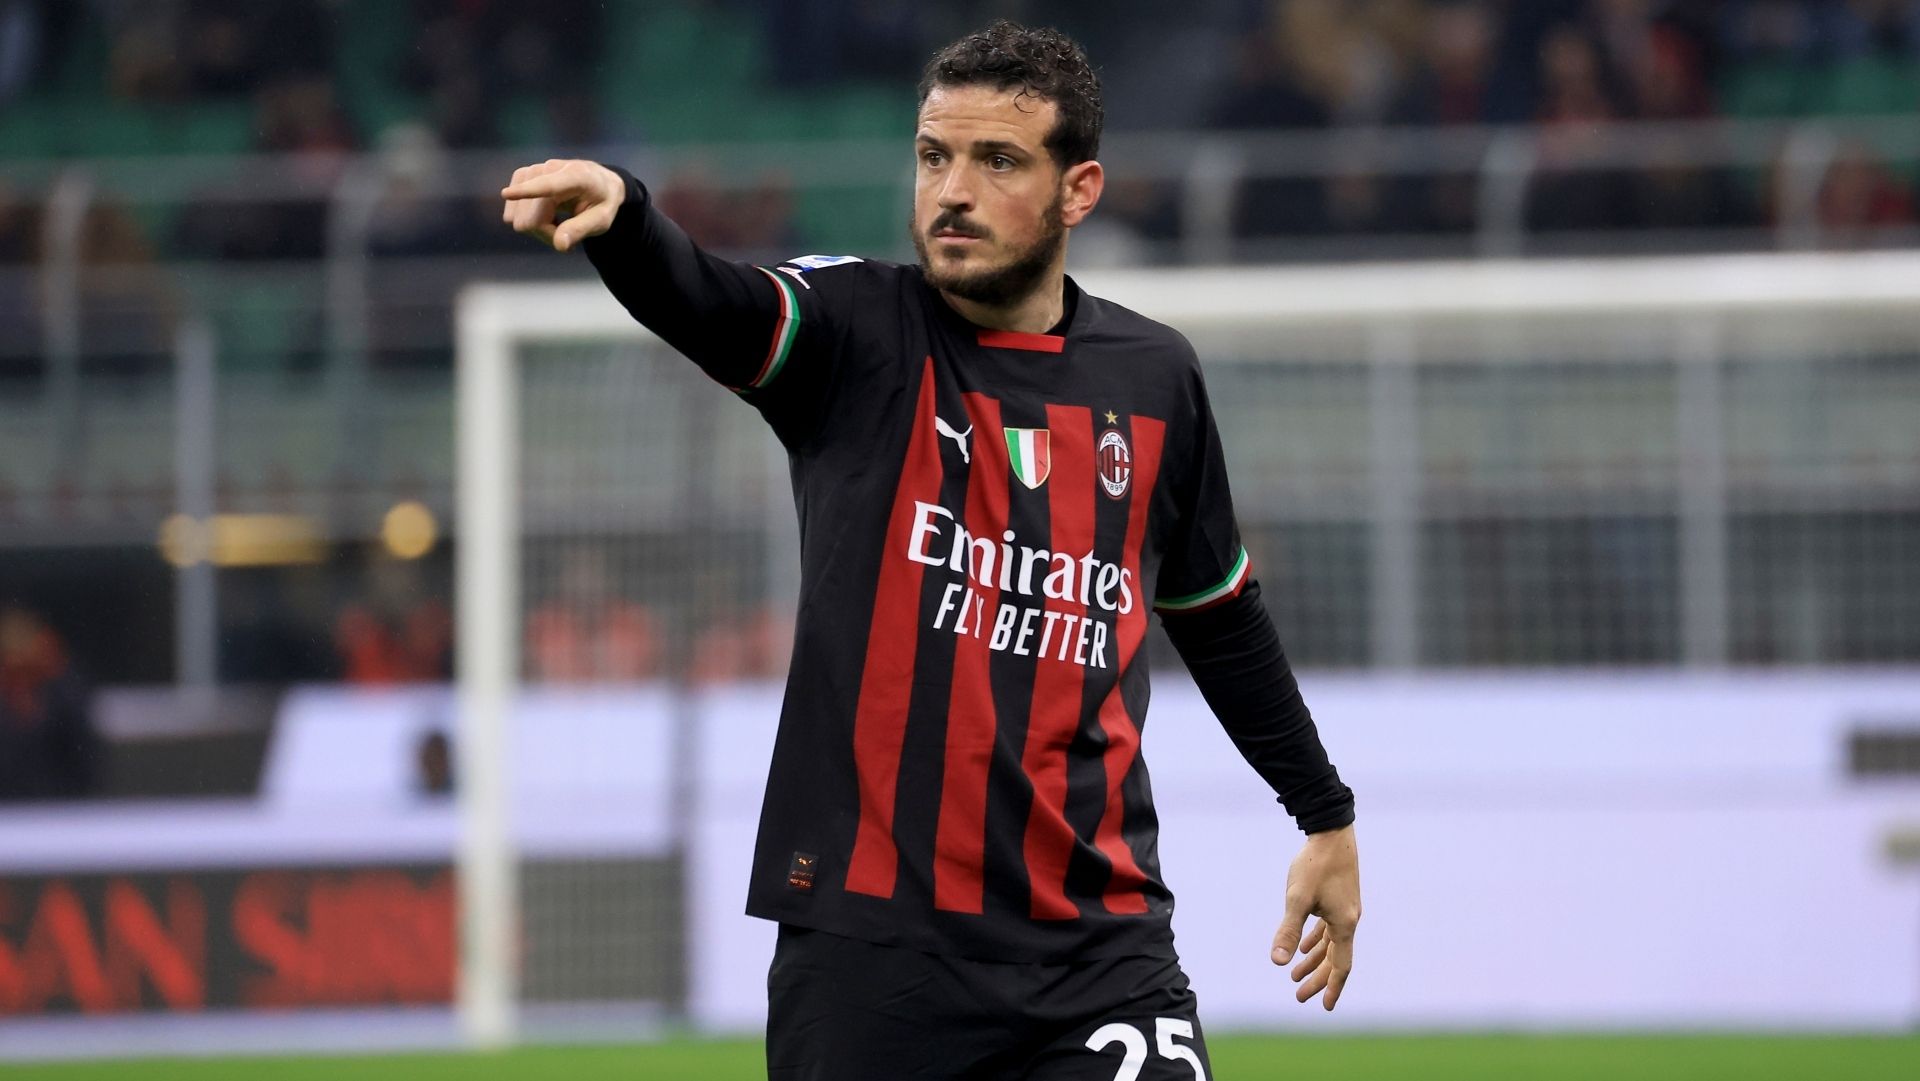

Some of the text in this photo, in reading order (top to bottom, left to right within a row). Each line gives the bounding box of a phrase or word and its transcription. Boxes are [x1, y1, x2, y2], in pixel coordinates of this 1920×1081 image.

[1103, 434, 1123, 446] ACM
[1106, 482, 1123, 492] 1899
[908, 501, 1132, 614] Emirates
[933, 583, 1107, 668] FLY BETTER
[0, 874, 206, 1014] AN
[1084, 1017, 1207, 1081] 25
